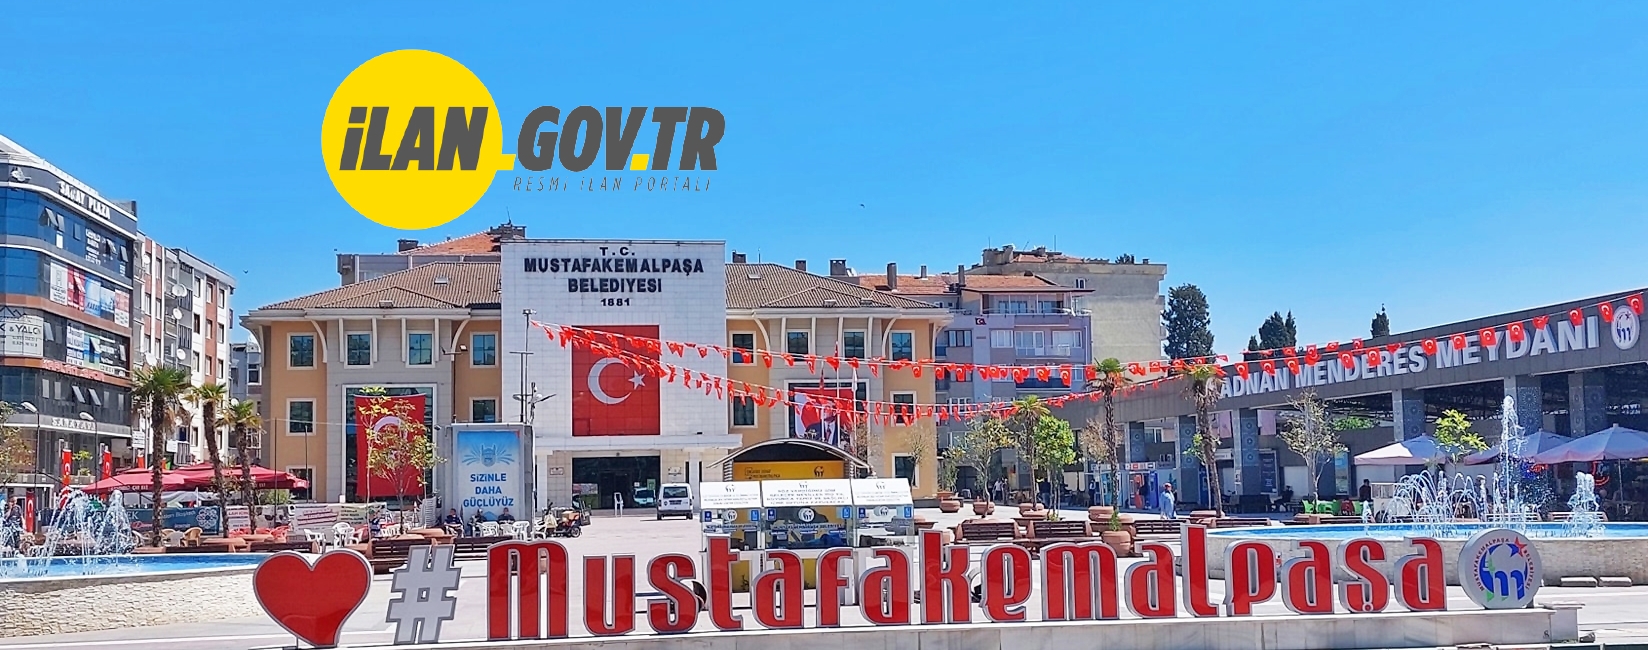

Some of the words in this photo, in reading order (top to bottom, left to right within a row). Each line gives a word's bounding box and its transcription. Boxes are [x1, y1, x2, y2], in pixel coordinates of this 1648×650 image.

[88, 195, 111, 220] PLAZA
[523, 257, 704, 277] MUSTAFAKEMALPAŞA
[600, 298, 630, 307] 1881
[1220, 366, 1290, 400] ADNAN
[1294, 344, 1430, 389] MENDERES
[1435, 315, 1600, 370] MEYDANI
[474, 485, 503, 495] DAHA
[462, 495, 514, 508] GÜÇLÜYÜZ
